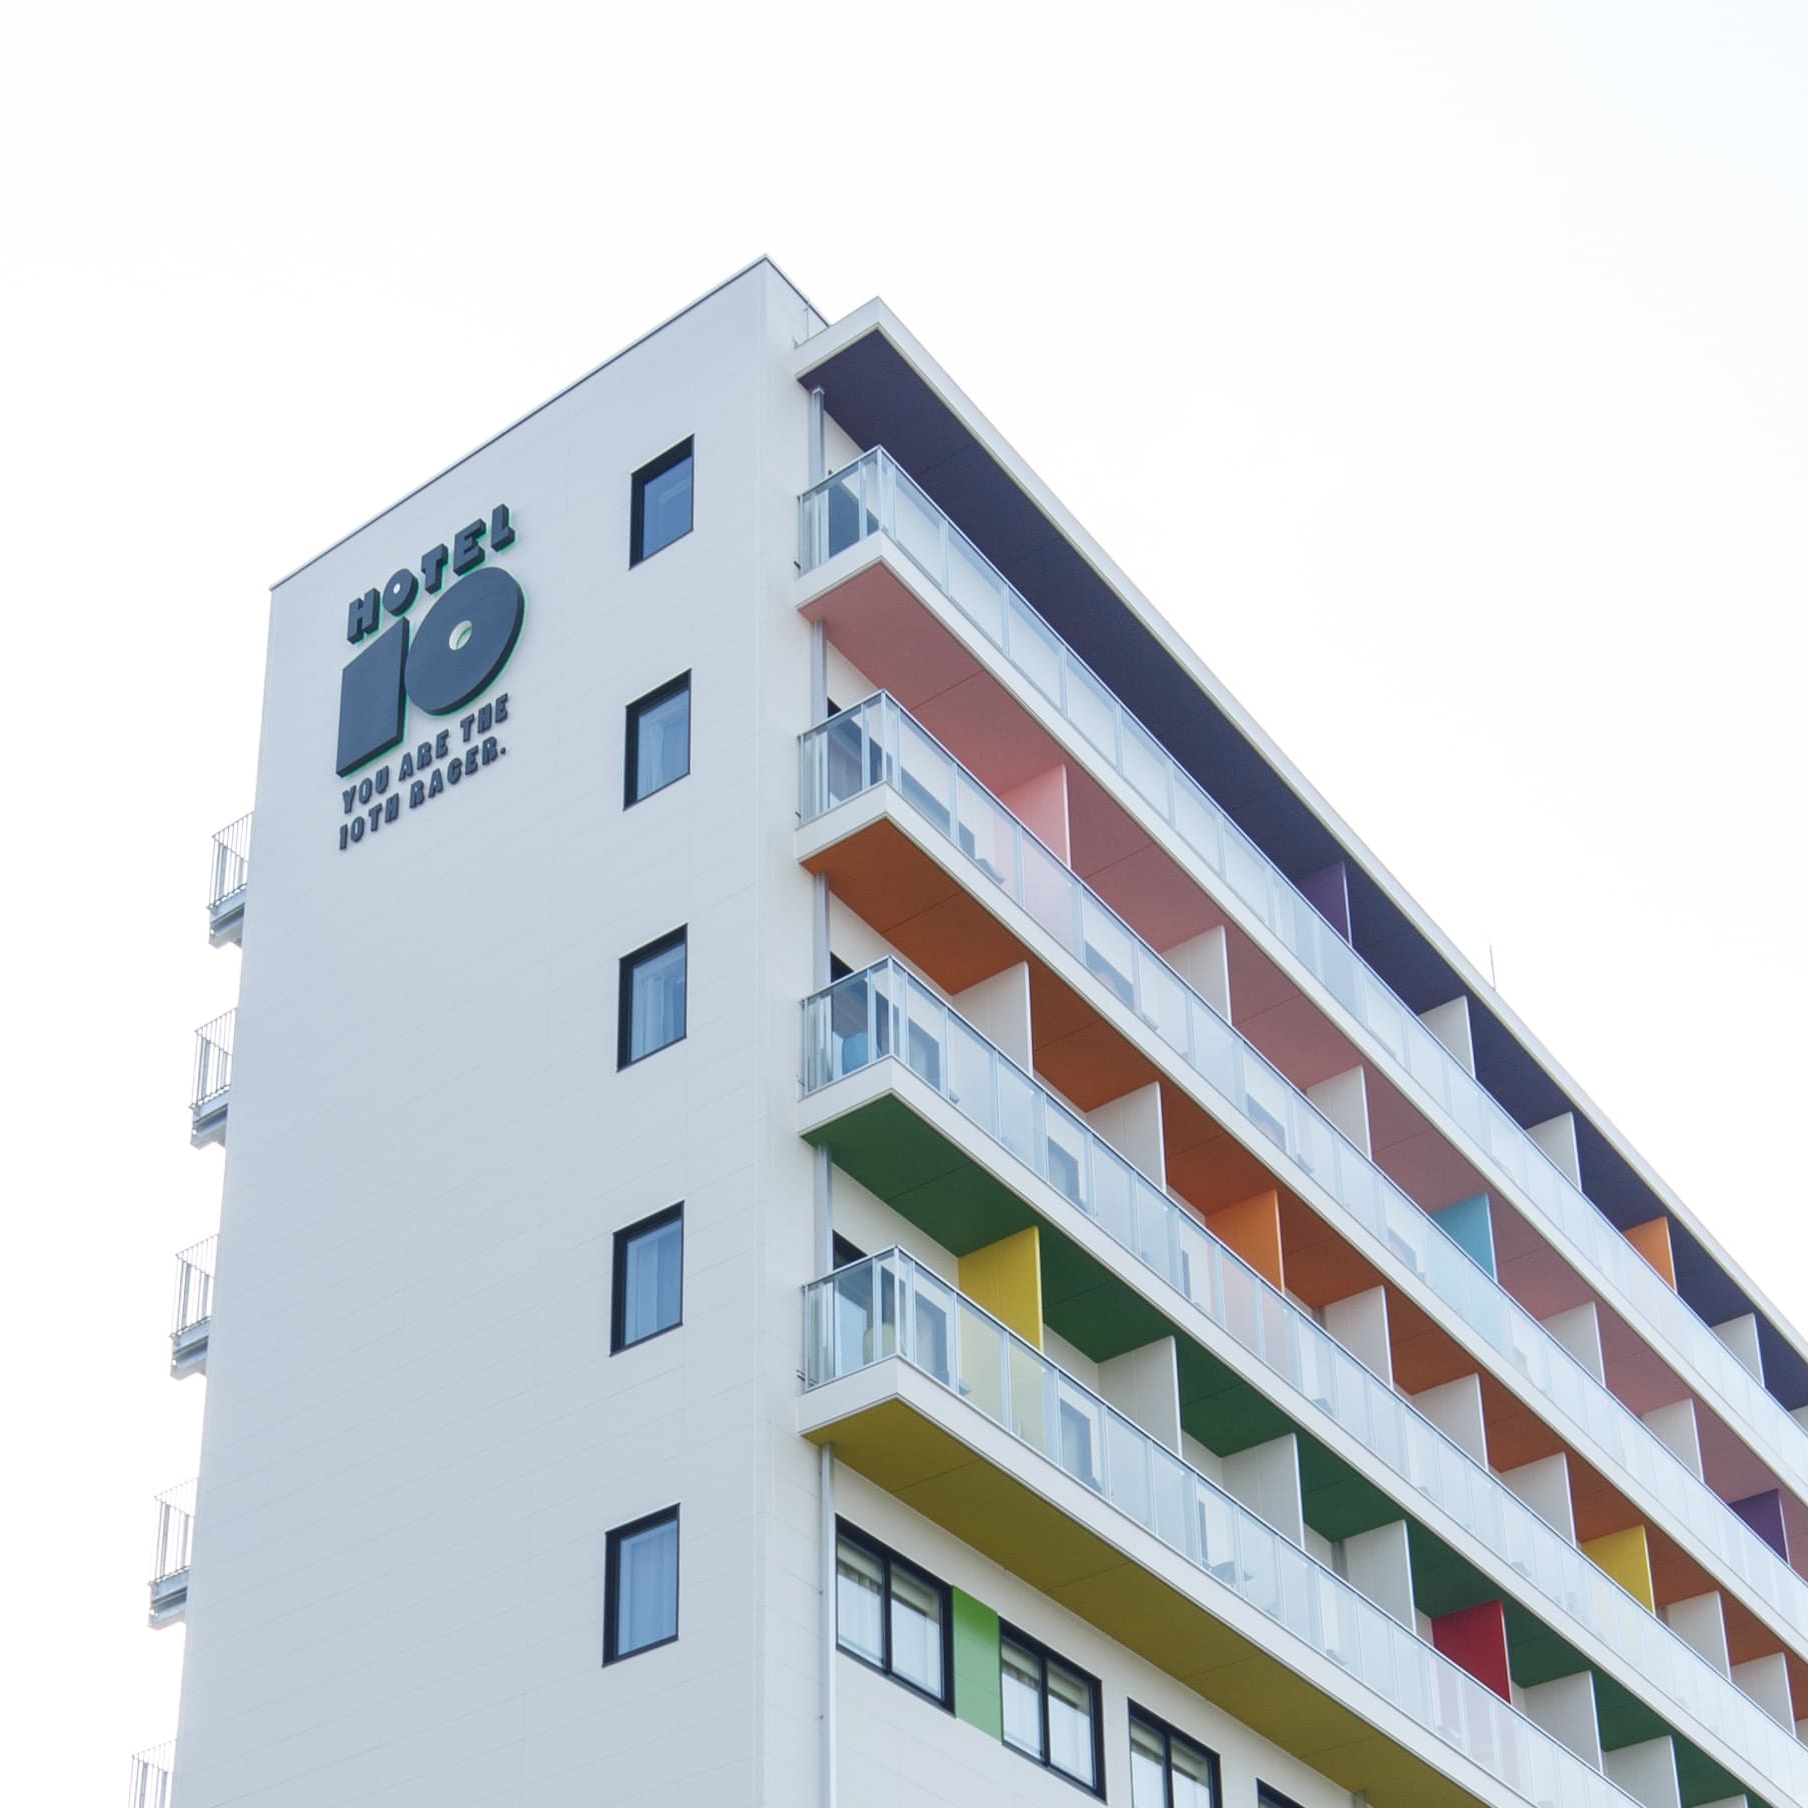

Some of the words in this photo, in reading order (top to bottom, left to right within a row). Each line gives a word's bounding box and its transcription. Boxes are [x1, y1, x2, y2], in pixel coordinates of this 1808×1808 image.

[347, 503, 516, 645] HOTEL
[335, 566, 526, 778] 10
[339, 793, 399, 851] 10TH
[409, 736, 507, 809] RACER.
[342, 765, 390, 815] YOU
[398, 728, 450, 782] ARE
[459, 693, 509, 743] THE
